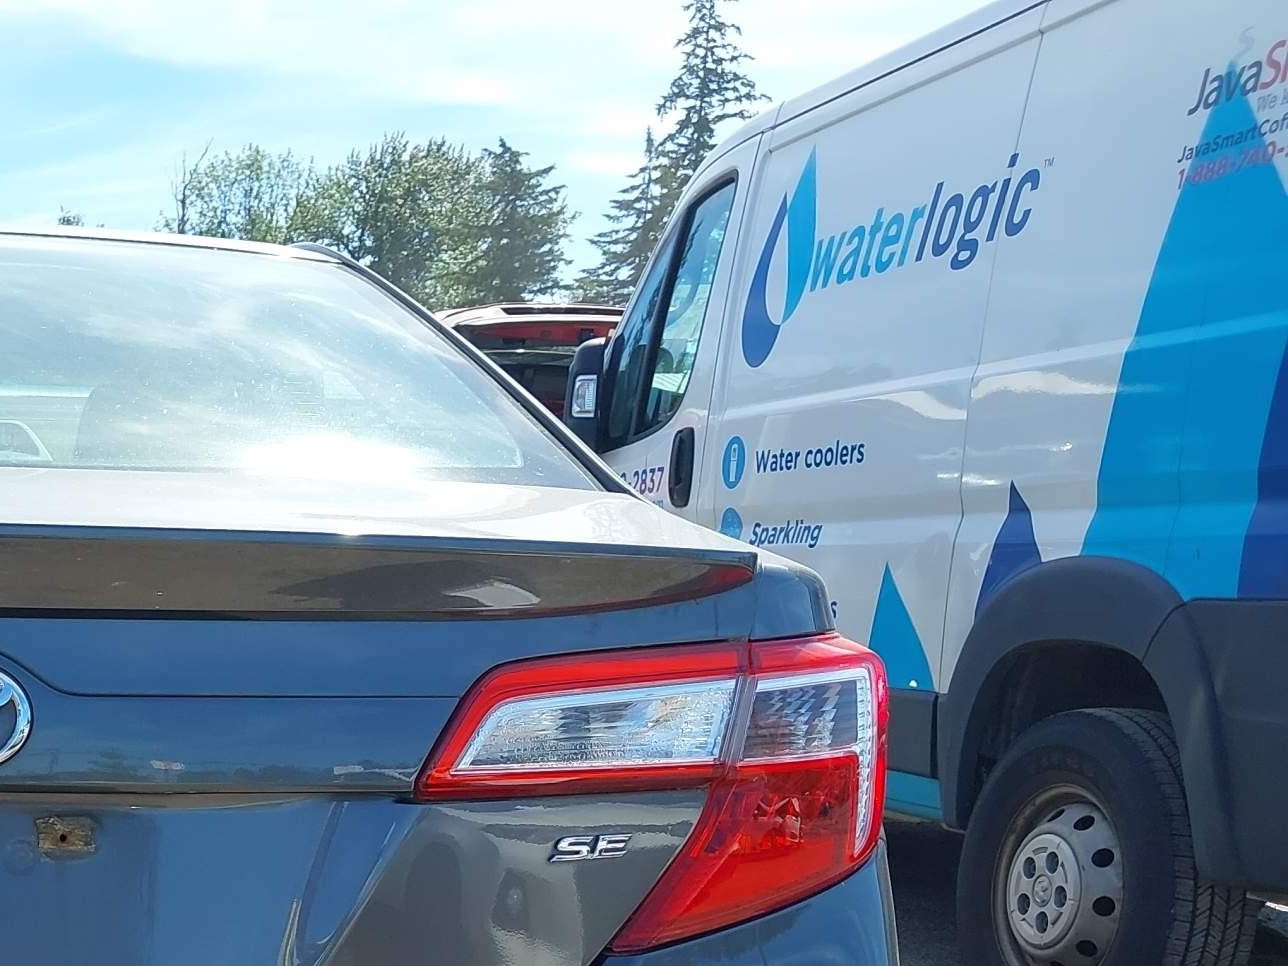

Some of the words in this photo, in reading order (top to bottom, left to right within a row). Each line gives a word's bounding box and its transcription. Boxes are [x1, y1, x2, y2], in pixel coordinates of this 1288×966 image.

[1187, 39, 1288, 116] JavaS
[1177, 111, 1288, 163] JavaSmartCof
[1177, 141, 1288, 190] 1-888-740-
[809, 153, 1041, 292] waterlogic
[755, 450, 799, 474] Water
[804, 440, 865, 469] coolers
[749, 519, 823, 548] Sparkling
[548, 832, 632, 862] SE
